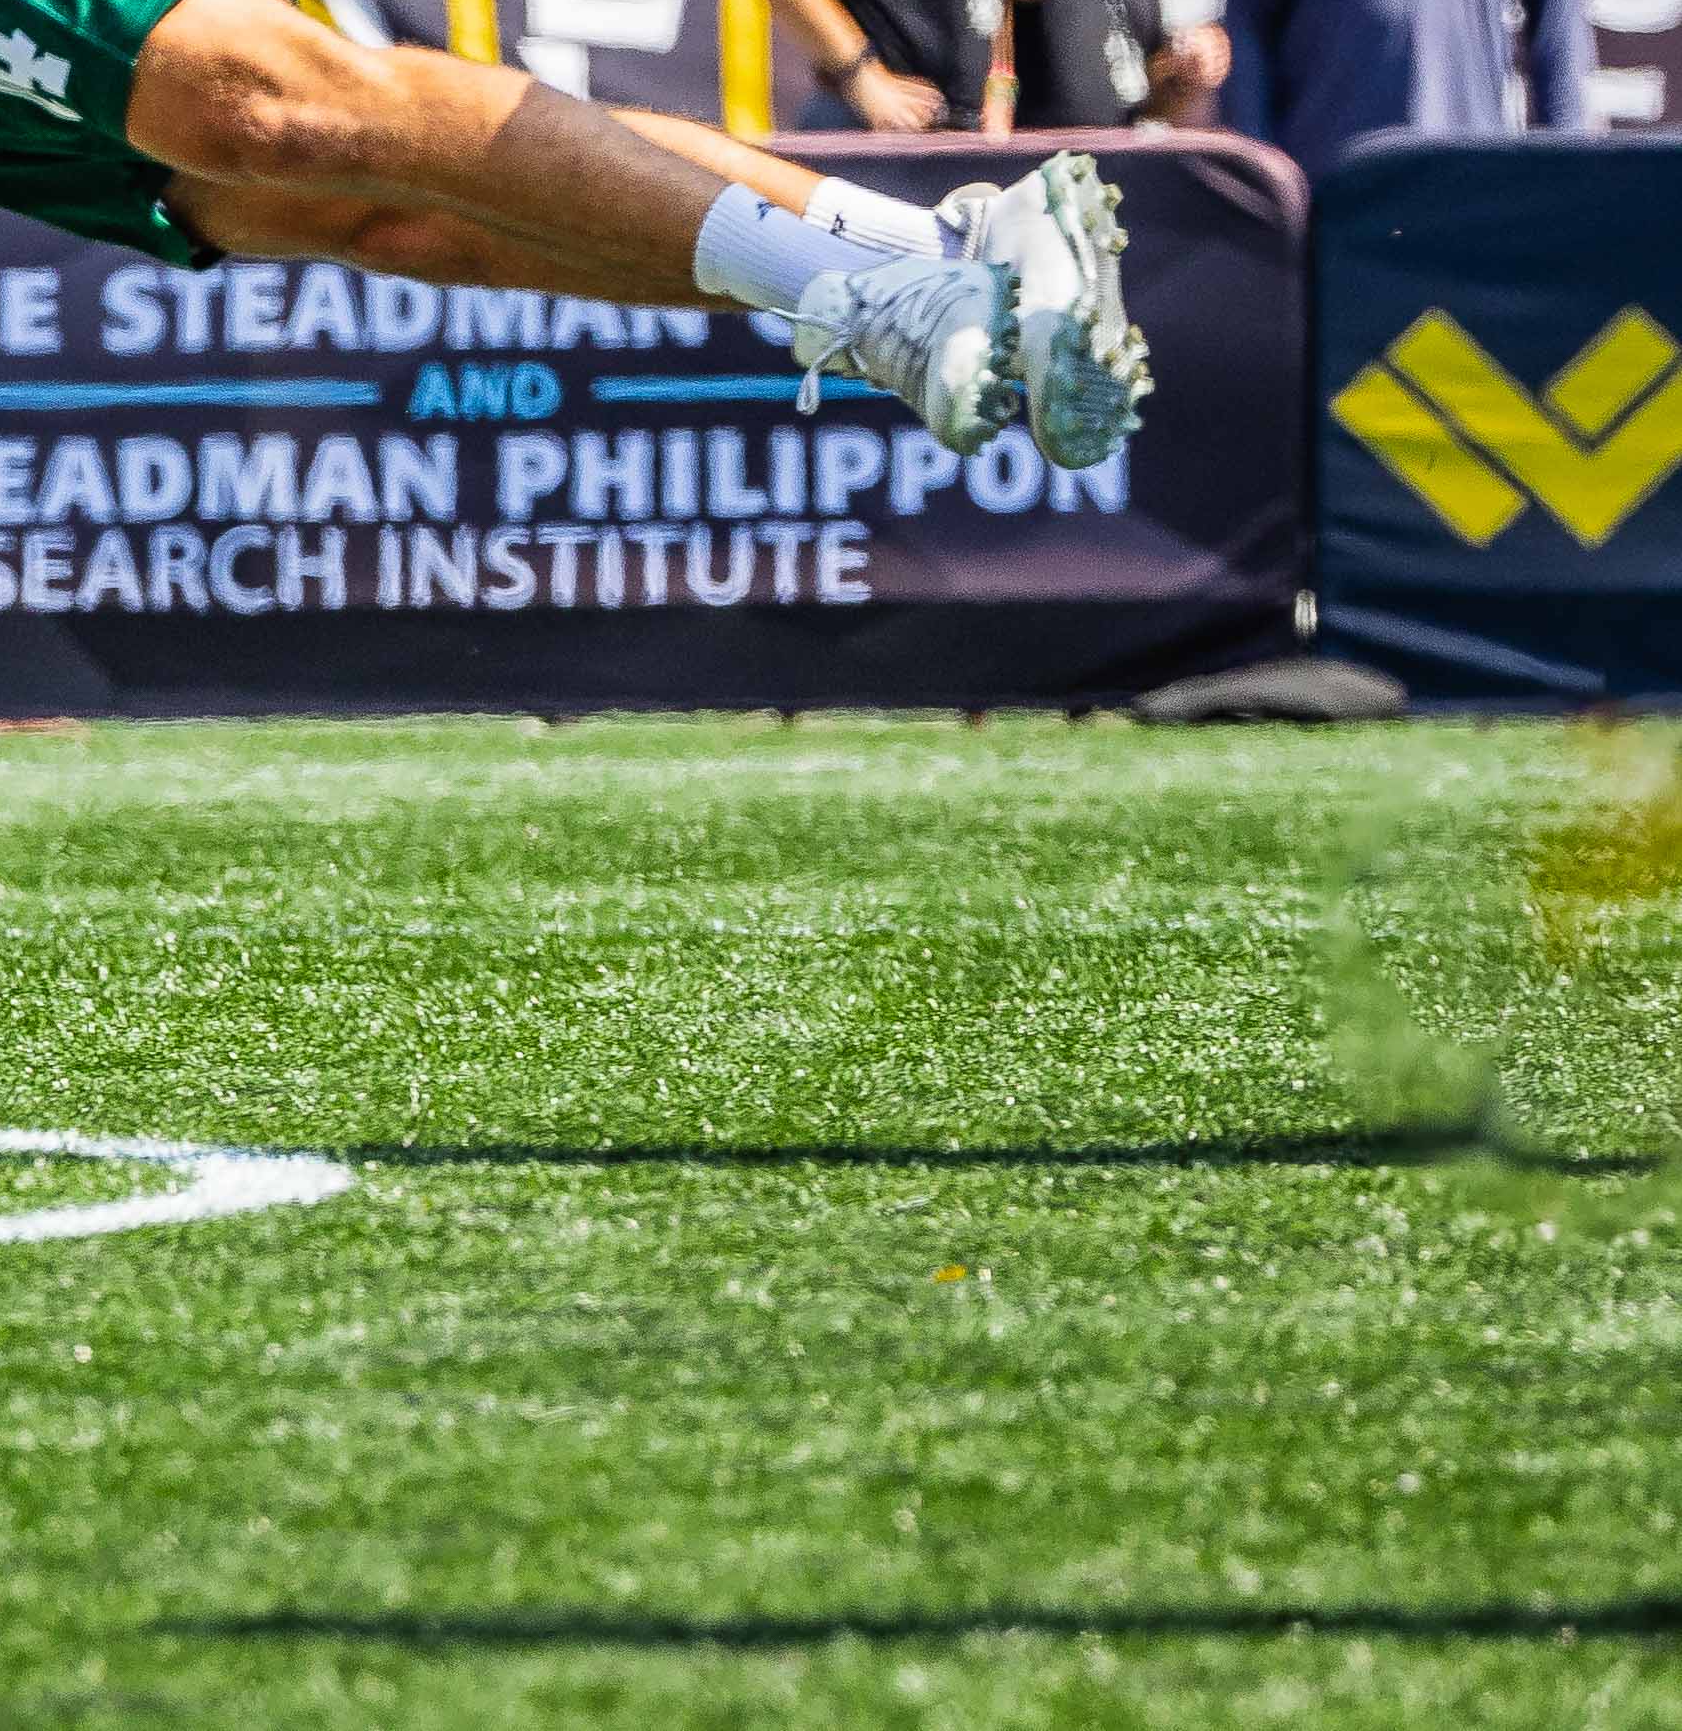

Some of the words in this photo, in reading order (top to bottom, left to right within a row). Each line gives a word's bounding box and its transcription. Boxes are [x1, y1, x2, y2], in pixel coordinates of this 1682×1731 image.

[101, 264, 711, 354] STEADMAN
[407, 362, 563, 420] AND
[493, 424, 1133, 520] PHILIPPON
[375, 520, 875, 612] INSTITUTE
